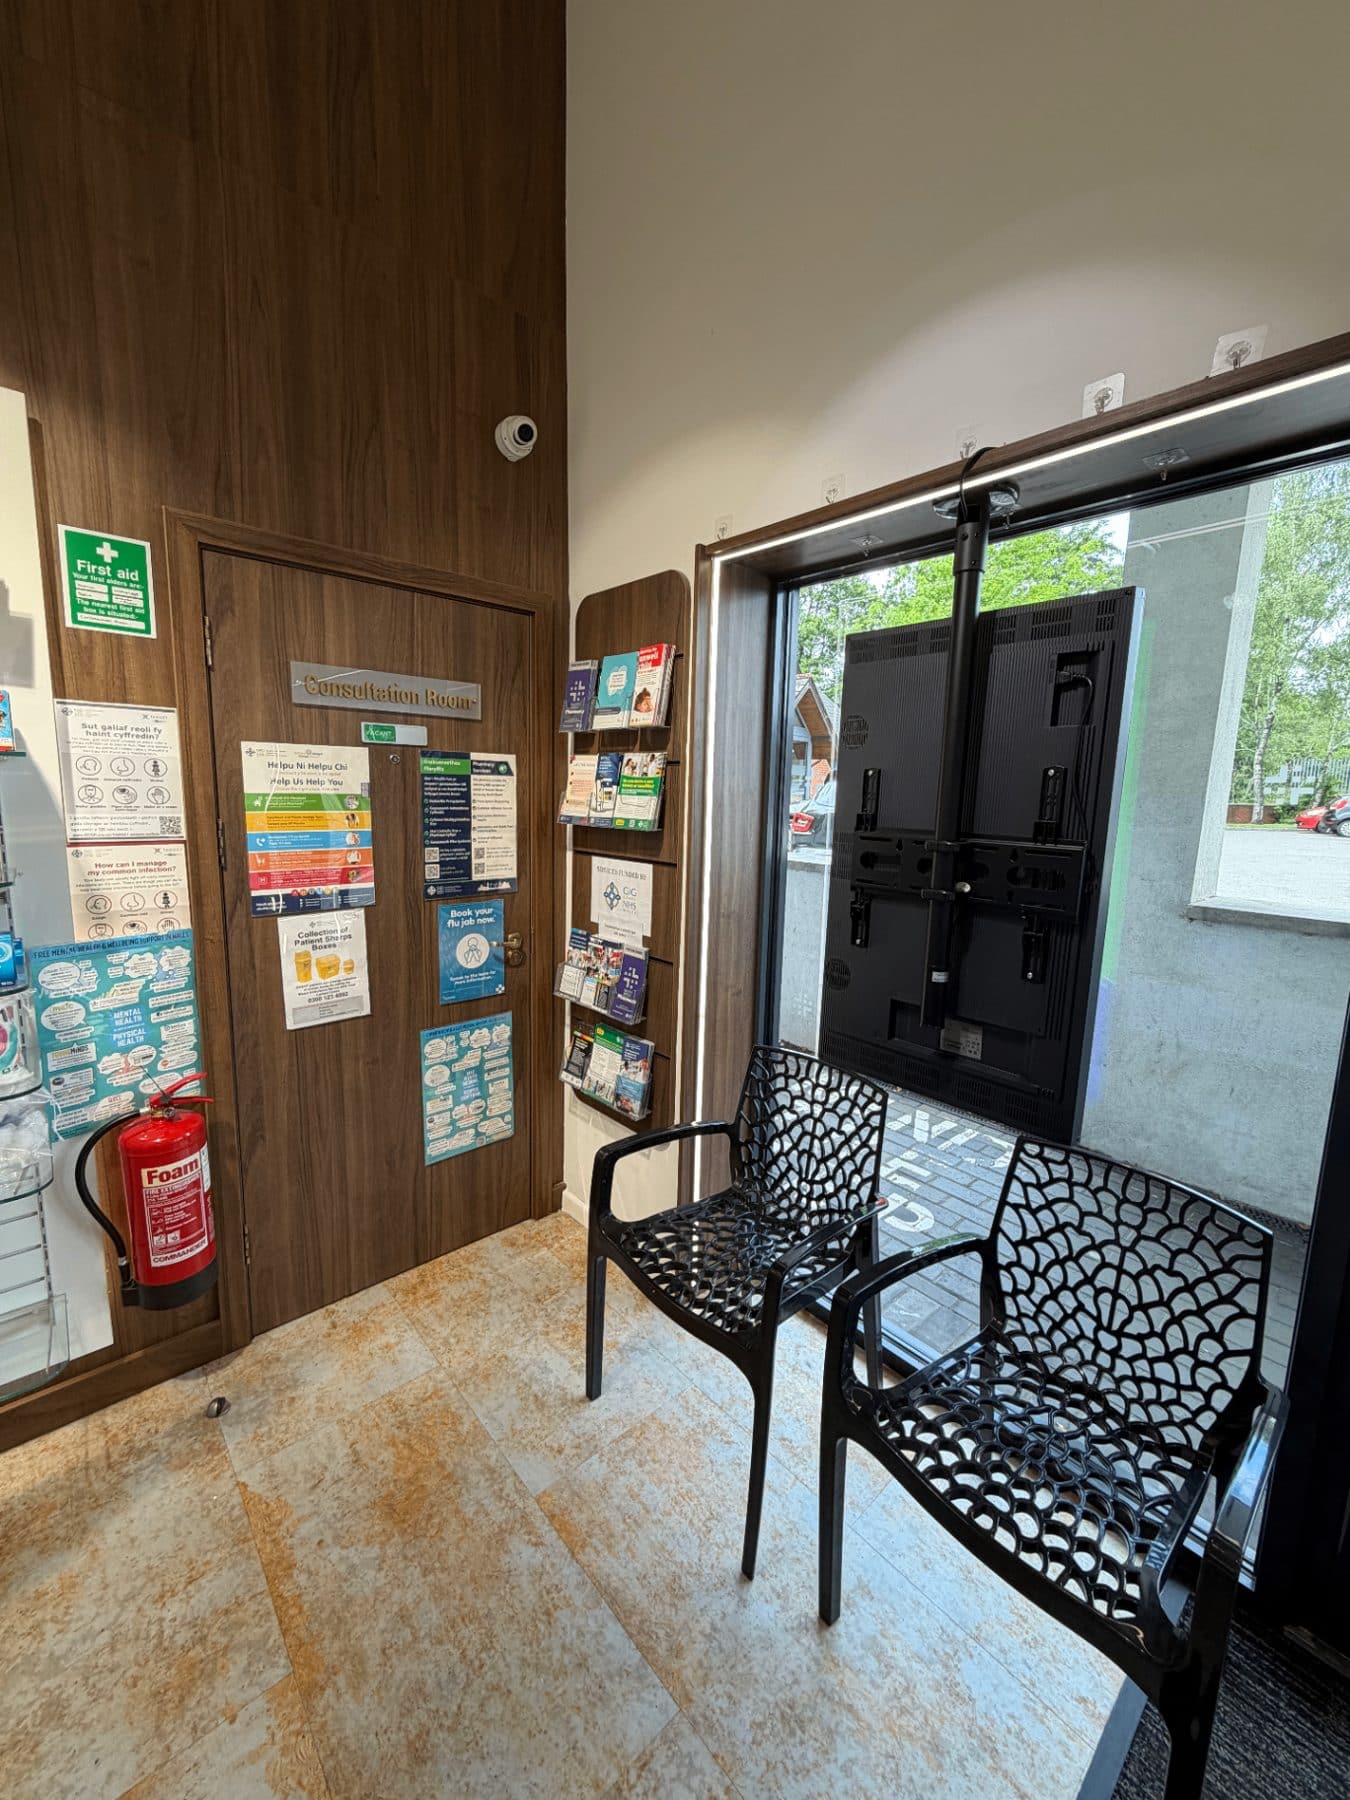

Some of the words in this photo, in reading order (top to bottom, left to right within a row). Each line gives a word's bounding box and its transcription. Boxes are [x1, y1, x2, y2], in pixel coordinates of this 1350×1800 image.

[77, 560, 111, 577] First
[117, 569, 139, 581] aid
[304, 674, 421, 705] Consultation
[425, 687, 476, 710] Room
[267, 761, 294, 771] Helpu
[308, 762, 332, 772] Helpu
[334, 763, 348, 771] Chi
[293, 778, 304, 786] Us
[306, 778, 326, 788] Help
[450, 909, 473, 918] Book
[475, 908, 494, 917] your
[447, 920, 460, 928] flu
[461, 917, 475, 928] jab
[298, 928, 338, 939] Collection
[294, 936, 323, 946] Patient
[312, 943, 337, 951] Boxes
[33, 949, 51, 959] FREE
[113, 1008, 141, 1019] MENTAL
[115, 1016, 142, 1026] HEALTH
[113, 1029, 145, 1041] PHYSICAL
[117, 1036, 144, 1047] HEALTH
[147, 1159, 199, 1185] Foam
